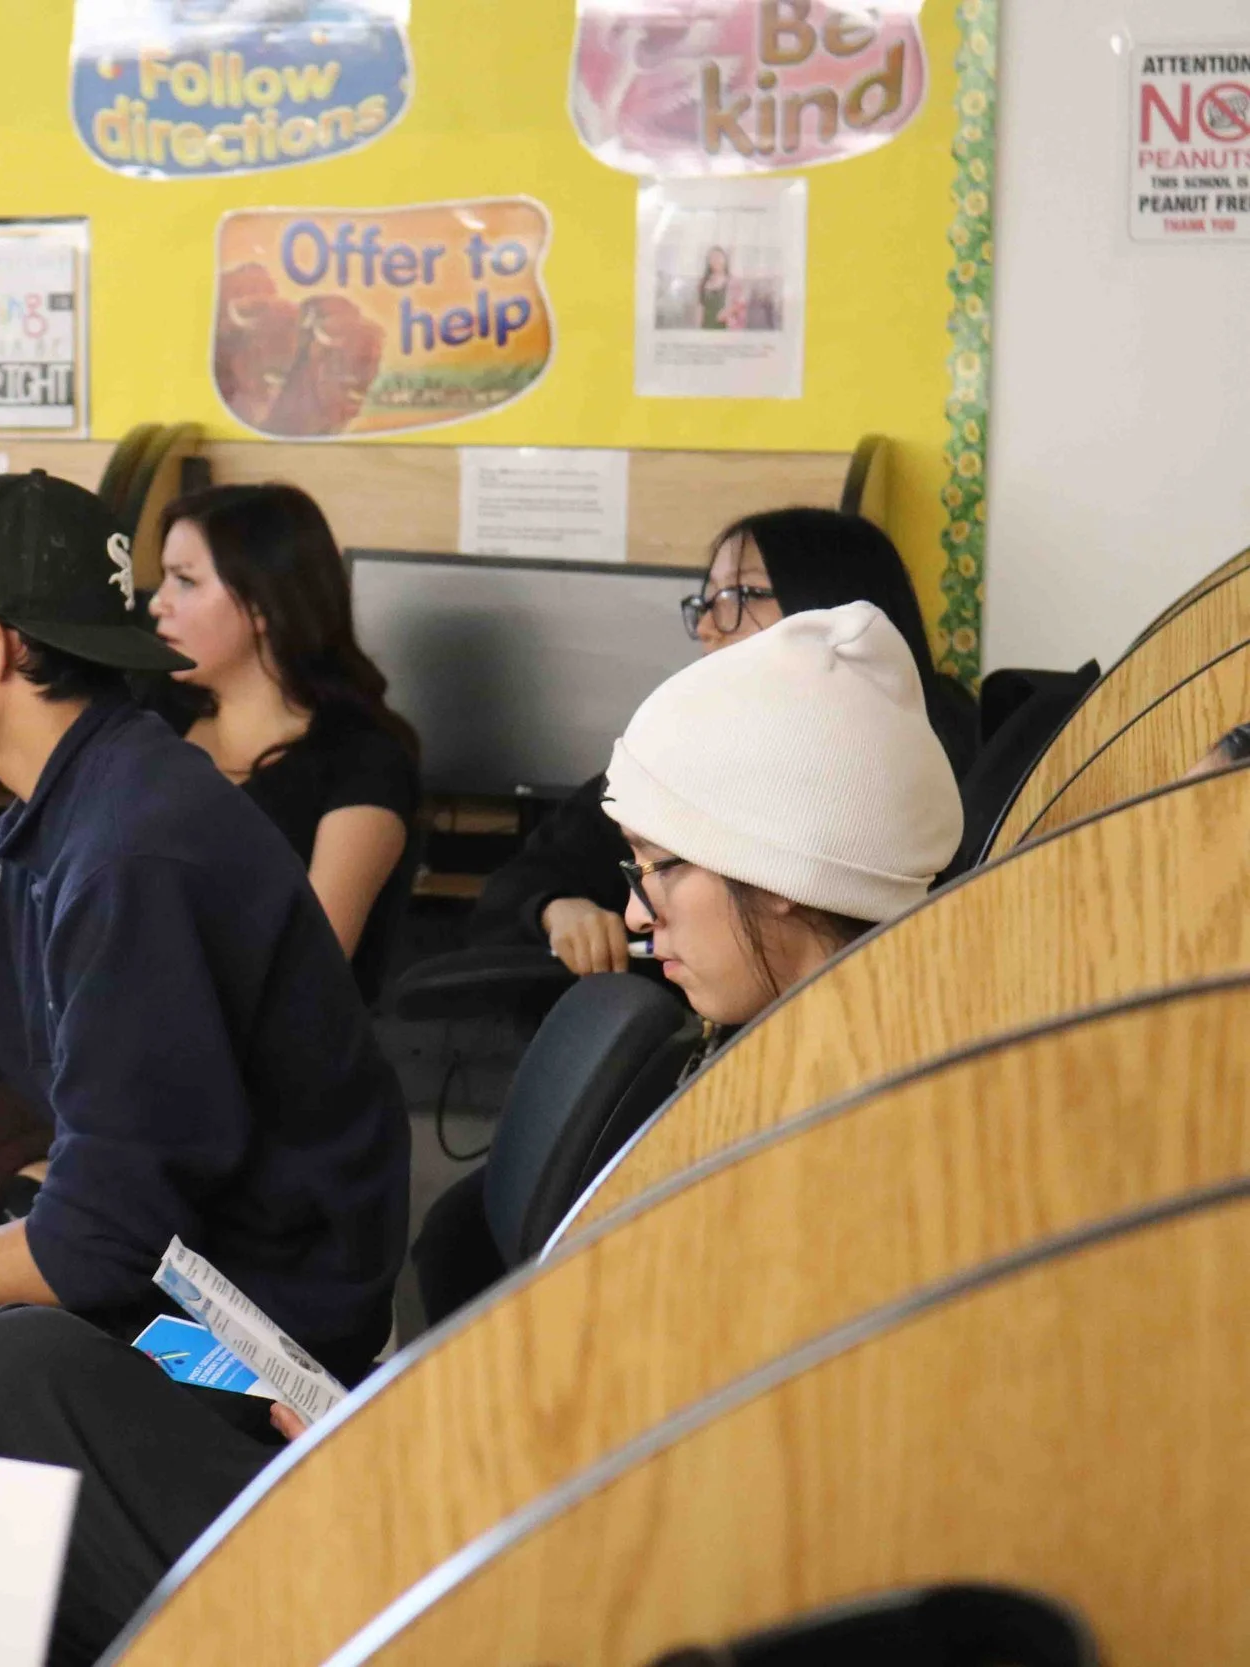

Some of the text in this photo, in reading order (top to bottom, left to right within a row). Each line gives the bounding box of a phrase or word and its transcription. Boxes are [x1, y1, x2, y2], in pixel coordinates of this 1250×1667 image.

[759, 0, 876, 65] Be
[138, 47, 341, 109] Follow
[700, 38, 906, 156] kind
[93, 94, 388, 168] directions
[1138, 194, 1250, 213] PEANUT FRE
[281, 219, 529, 288] Offer to
[400, 289, 533, 355] help
